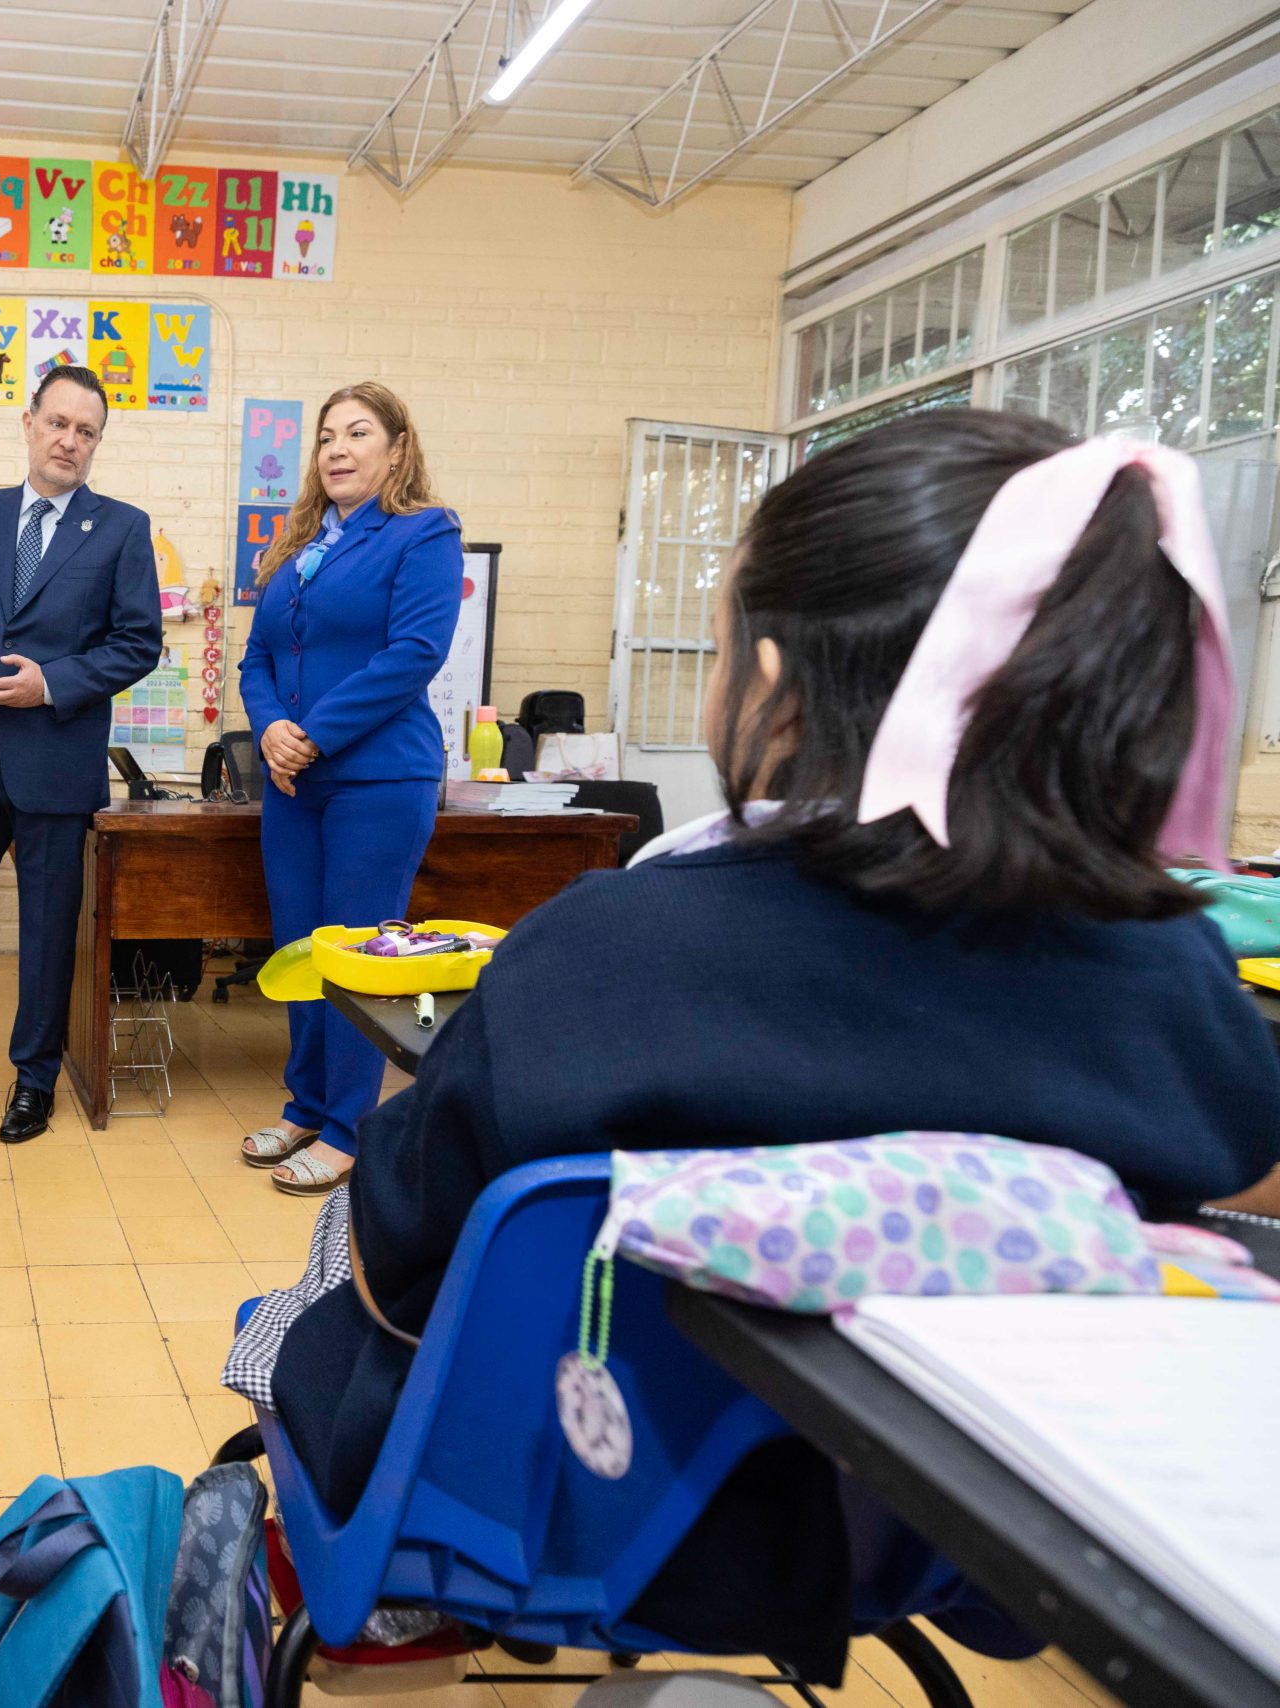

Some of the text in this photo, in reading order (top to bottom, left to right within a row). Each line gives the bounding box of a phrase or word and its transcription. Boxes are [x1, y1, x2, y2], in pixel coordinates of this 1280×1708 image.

[35, 167, 86, 200] Vv
[97, 169, 149, 205] Ch
[160, 174, 209, 208] Zz
[224, 177, 262, 211] Ll
[281, 180, 333, 216] Hh
[101, 204, 147, 237] ch
[243, 216, 273, 252] ll
[45, 252, 75, 263] vaca
[100, 255, 145, 271] chango
[168, 257, 201, 270] zorro
[224, 257, 262, 273] llaves
[282, 261, 325, 276] helado
[31, 309, 83, 340] Xx
[92, 311, 122, 341] K
[108, 392, 137, 404] osko
[249, 407, 297, 448] Pp
[251, 485, 287, 500] pulpo
[443, 672, 453, 683] 10
[443, 690, 454, 700] 12
[443, 707, 454, 717] 14
